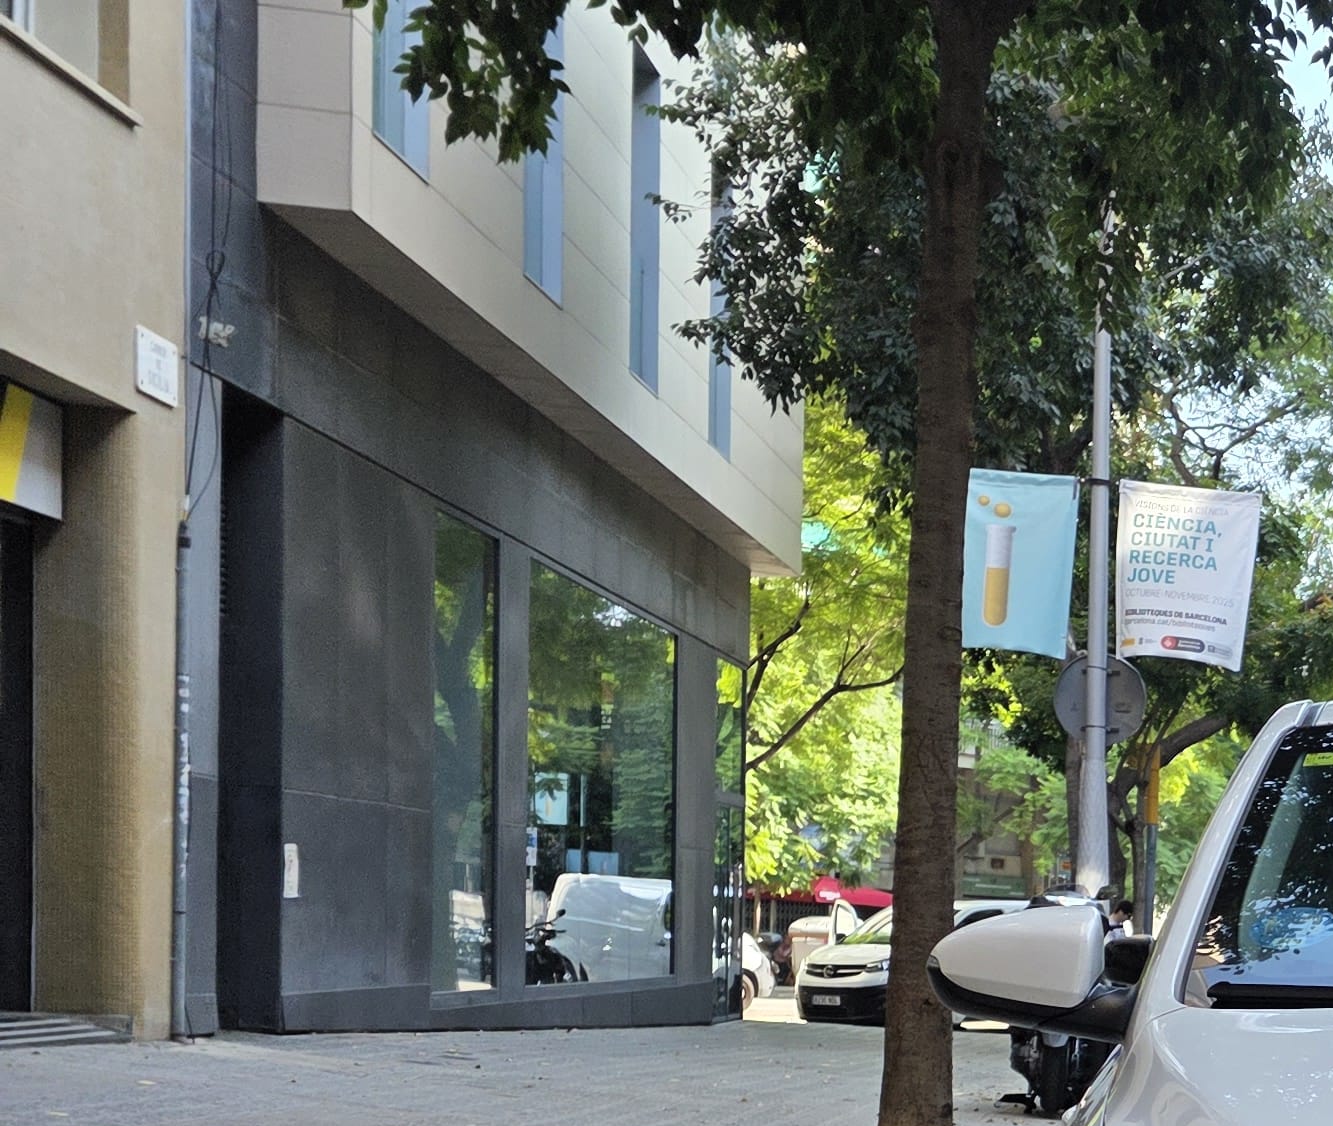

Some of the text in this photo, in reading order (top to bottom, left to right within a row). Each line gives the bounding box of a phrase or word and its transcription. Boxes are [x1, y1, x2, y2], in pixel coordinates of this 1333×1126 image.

[1133, 513, 1222, 538] CIÈNCIA,
[1131, 532, 1214, 552] CIUTAT I
[1128, 550, 1217, 571] RECERCA
[1127, 568, 1176, 584] JOVE
[1124, 608, 1228, 625] BIBLIOTEQUES DE BARCELONA
